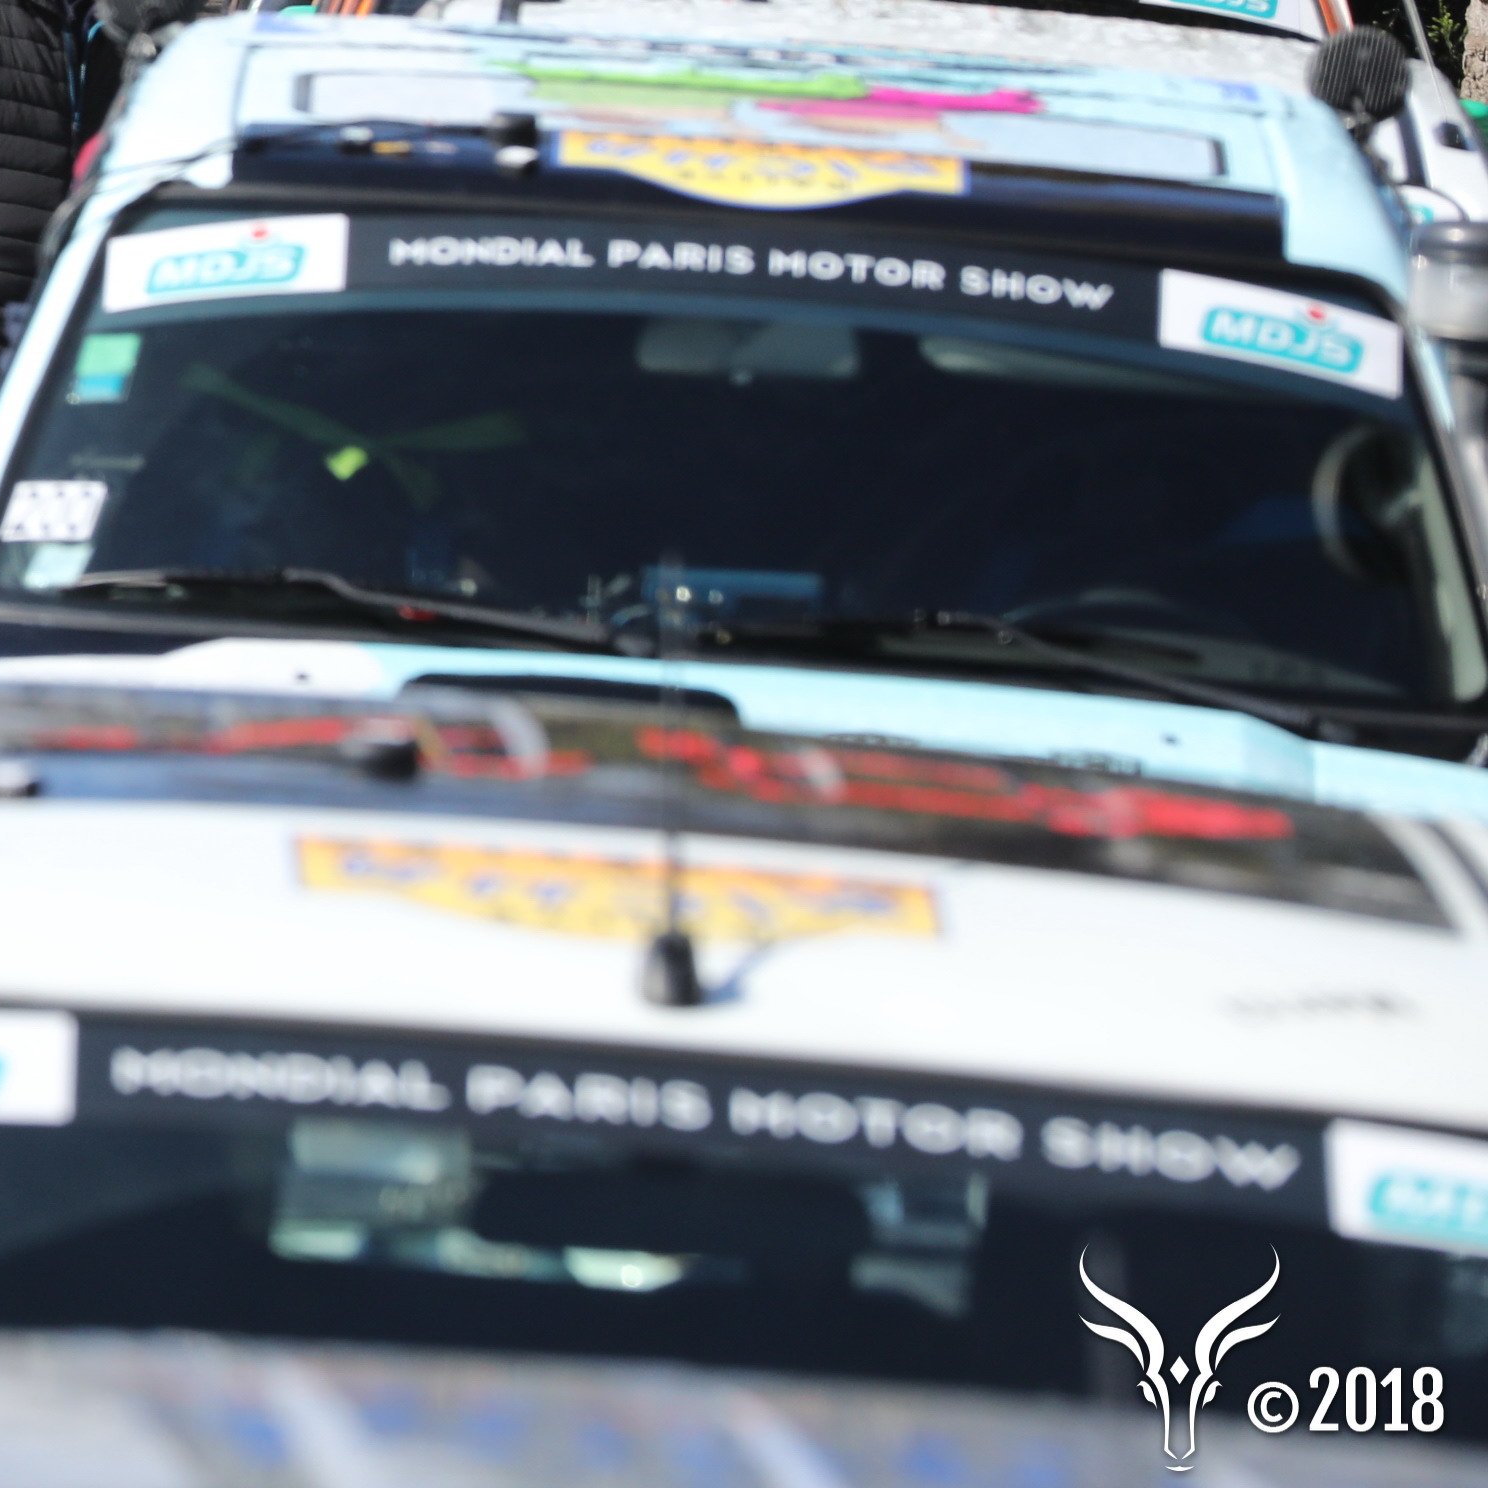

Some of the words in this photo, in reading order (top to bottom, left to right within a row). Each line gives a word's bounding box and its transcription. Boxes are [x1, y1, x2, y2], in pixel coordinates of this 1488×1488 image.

[155, 242, 305, 290] MDJS
[388, 234, 594, 269] MONDIAL
[607, 238, 756, 275] PARIS
[769, 248, 947, 292] MOTOR
[960, 264, 1114, 312] SHOW
[1212, 311, 1361, 371] MDJS
[108, 1044, 454, 1116] MONDIAL
[462, 1061, 716, 1134] PARIS
[727, 1084, 1025, 1162] MOTOR
[1037, 1114, 1304, 1193] SHOW
